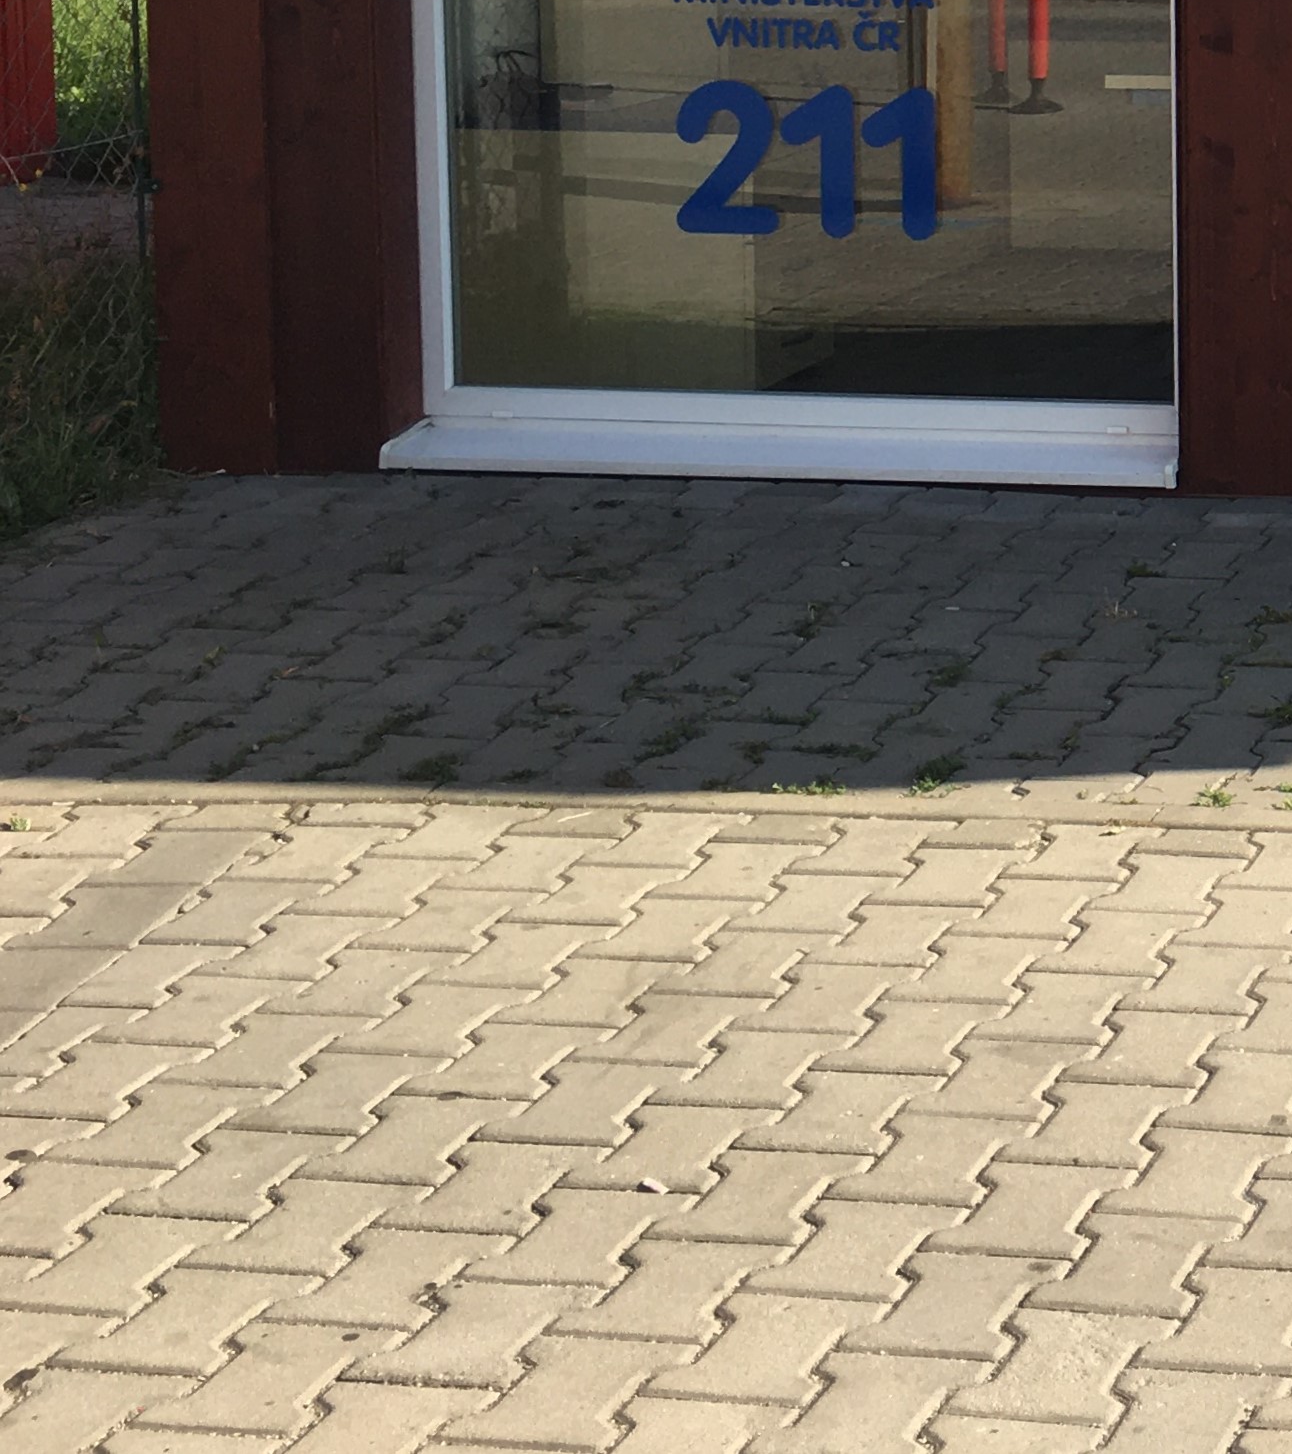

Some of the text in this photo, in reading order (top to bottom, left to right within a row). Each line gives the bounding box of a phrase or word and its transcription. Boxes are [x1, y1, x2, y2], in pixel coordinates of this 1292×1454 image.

[706, 10, 901, 52] VNITRA ČR
[675, 79, 938, 240] 211
